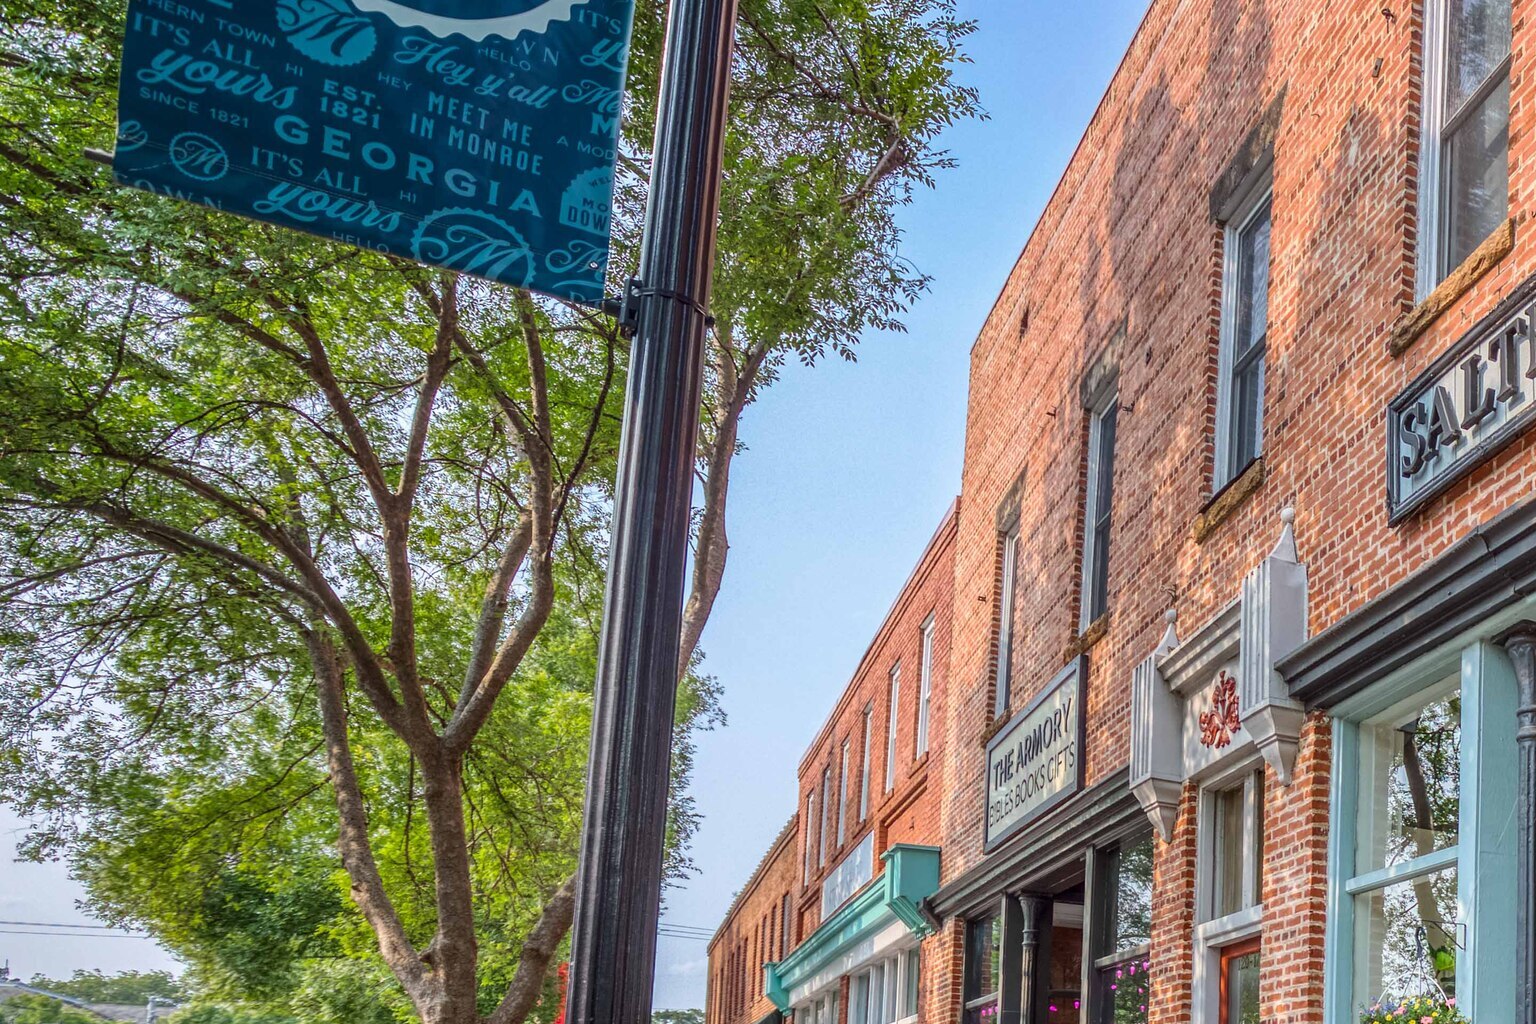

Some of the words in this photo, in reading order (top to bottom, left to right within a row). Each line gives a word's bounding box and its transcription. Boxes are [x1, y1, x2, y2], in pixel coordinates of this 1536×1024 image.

[133, 12, 191, 46] IT'S
[203, 38, 260, 69] ALL
[216, 17, 276, 47] TOWN
[578, 8, 622, 35] IT'S
[136, 48, 298, 109] yours
[285, 62, 304, 77] HI
[393, 36, 475, 86] Hey
[474, 72, 558, 109] y'all
[478, 46, 531, 71] HELLO
[323, 79, 382, 110] EST.
[378, 72, 413, 91] HEY
[139, 87, 200, 114] SINCE
[209, 108, 249, 128] 1821
[319, 96, 380, 129] 1821
[428, 91, 490, 130] MEET
[502, 118, 532, 146] ME
[410, 112, 434, 139] IN
[448, 125, 543, 176] MONROE
[556, 135, 569, 147] A
[251, 146, 304, 177] IT'S
[314, 167, 368, 196] ALL
[274, 115, 543, 218] GEORGIA
[252, 181, 404, 232] yours
[400, 190, 416, 203] HI
[993, 748, 1014, 791] THE
[1016, 697, 1071, 774] ARMORY
[989, 789, 1014, 828] BIBLES
[1015, 763, 1045, 809] BOOKS
[1047, 740, 1075, 782] GIFTS
